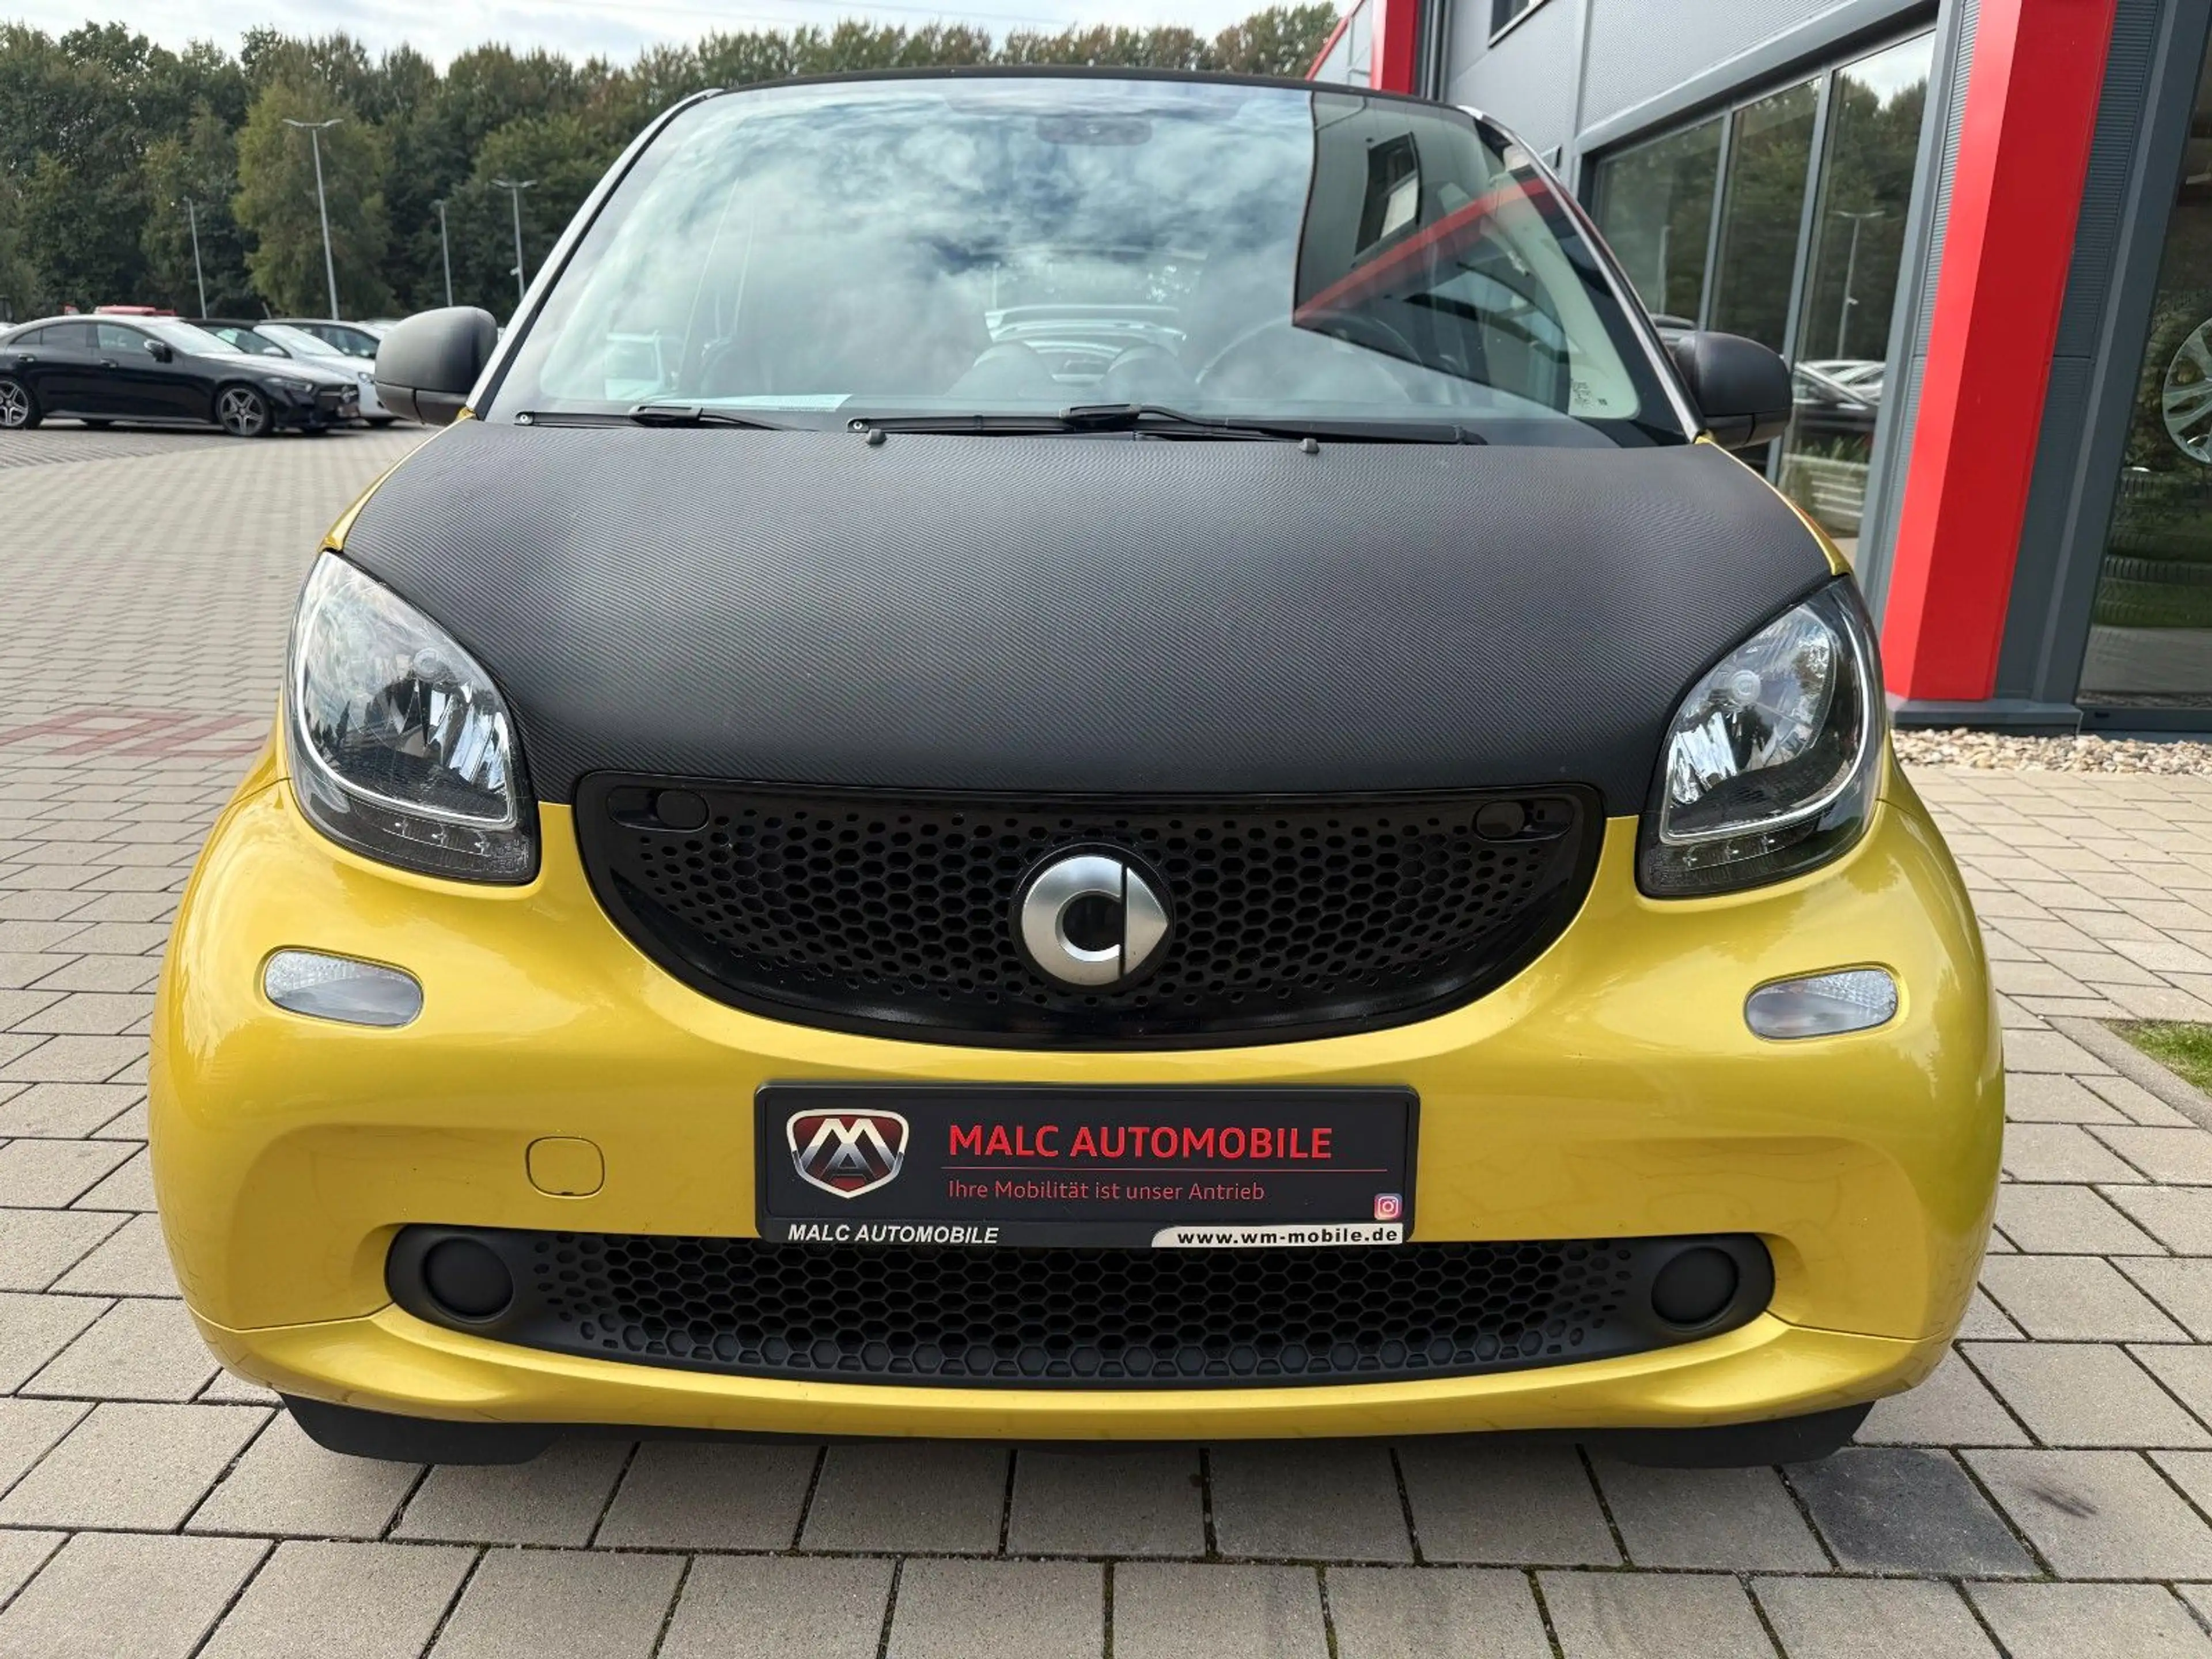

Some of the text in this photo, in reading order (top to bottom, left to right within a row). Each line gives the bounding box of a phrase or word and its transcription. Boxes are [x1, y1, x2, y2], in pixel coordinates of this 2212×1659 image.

[949, 1125, 1332, 1159] MALC AUTOMOBILE
[949, 1181, 1264, 1200] Ihre Mobilität ist unser Antrieb
[788, 1224, 999, 1244] MALC AUTOMOBILE
[1177, 1228, 1398, 1244] www.wm-mobile.de
